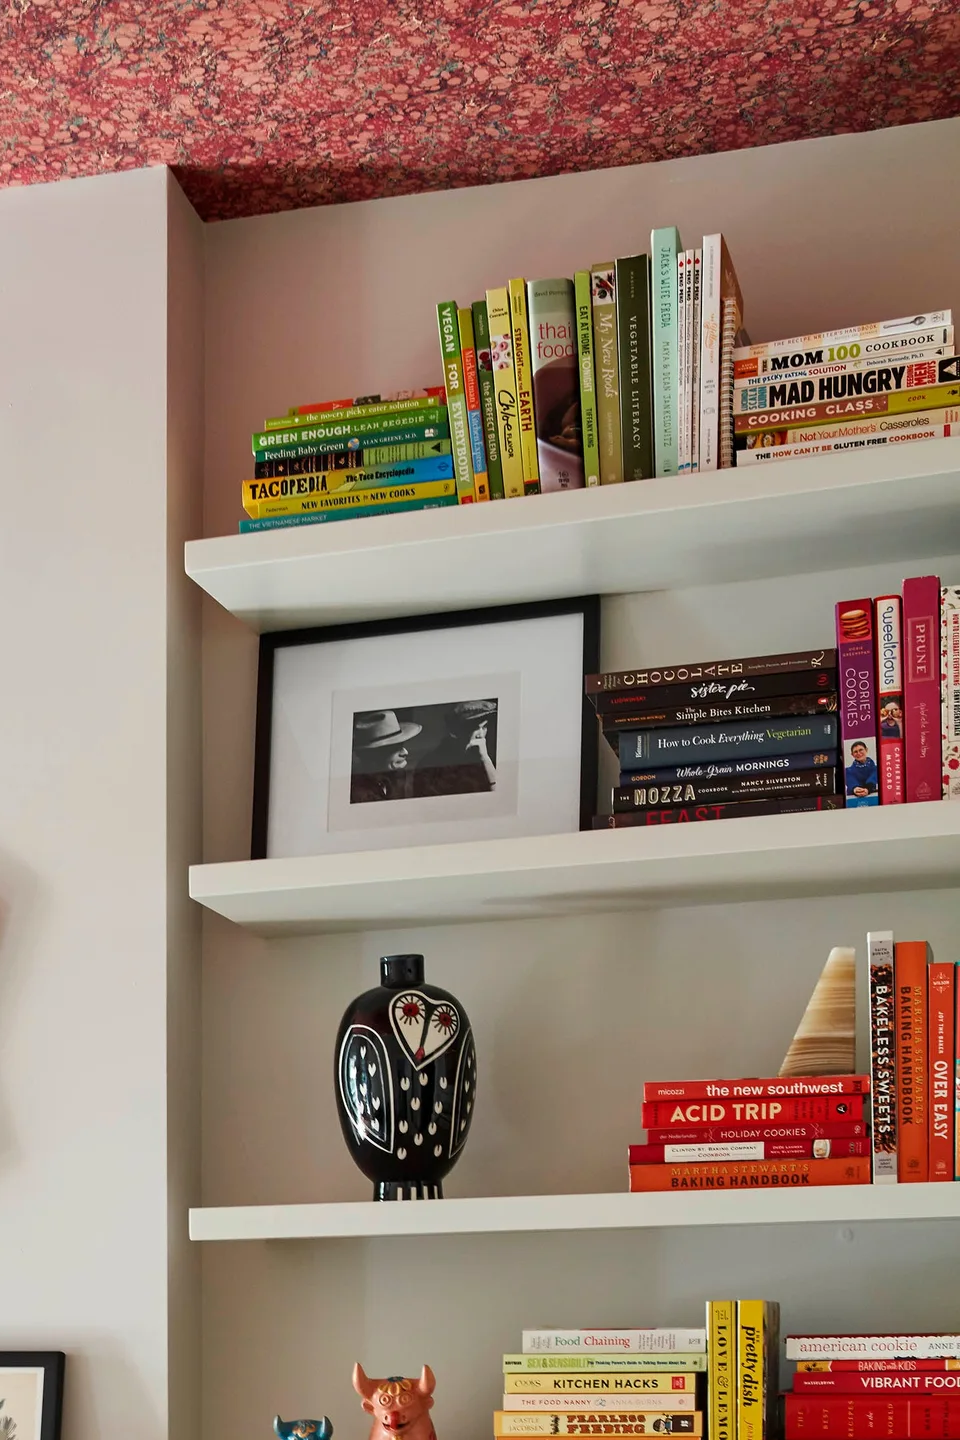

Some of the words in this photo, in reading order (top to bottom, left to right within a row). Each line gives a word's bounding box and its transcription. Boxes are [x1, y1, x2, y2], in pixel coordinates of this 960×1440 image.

[579, 306, 588, 320] EAT
[596, 313, 613, 333] My
[442, 307, 456, 353] VEGAN
[538, 322, 571, 340] thai
[581, 322, 589, 331] AT
[537, 341, 575, 359] food
[581, 333, 590, 356] HOME
[601, 337, 613, 365] New
[629, 315, 641, 384] VEGETABLE
[771, 350, 824, 371] MOM
[828, 343, 861, 362] 100
[865, 334, 935, 352] COOKBOOK
[448, 363, 459, 390] FOR
[514, 328, 524, 367] STRAIGHT
[520, 390, 532, 432] EARTH
[582, 356, 592, 393] TONIGHT
[601, 369, 618, 399] Roots
[914, 362, 927, 386] MEN
[769, 379, 815, 408] MAD
[819, 366, 906, 400] HUNGRY
[631, 390, 641, 449] LITERACY
[748, 408, 817, 425] COOKING
[825, 400, 874, 415] CLASS
[259, 432, 298, 447] GREEN
[301, 425, 351, 440] ENOUGH
[353, 422, 380, 431] LEAH
[452, 401, 470, 482] EVERYBODY
[800, 432, 816, 443] Not
[817, 430, 837, 439] Your
[838, 423, 877, 436] Mother's
[879, 417, 930, 431] Casseroles
[265, 449, 297, 461] Feeding
[297, 445, 318, 457] Baby
[319, 442, 345, 453] Green
[755, 452, 771, 460] THE
[772, 450, 792, 458] HOW
[833, 440, 865, 450] GLUTEN
[866, 437, 888, 446] FREE
[888, 430, 935, 443] COOKBOOK
[249, 475, 328, 500] TACOPEDIA
[345, 474, 358, 482] The
[359, 472, 374, 481] Taco
[375, 467, 415, 480] Encyclopedia
[301, 501, 319, 510] NEW
[320, 495, 361, 508] FAVORITES
[369, 491, 388, 501] NEW
[389, 488, 416, 499] COOKS
[249, 521, 261, 529] THE
[261, 518, 300, 528] VIETNAMESE
[301, 514, 328, 523] MARKET
[882, 606, 899, 685] weelicious
[915, 624, 927, 675] PRUNE
[623, 663, 743, 686] CHOCOLATE
[845, 668, 859, 727] COOKIES
[858, 670, 871, 721] DORIE'S
[676, 709, 707, 722] Simple
[709, 708, 732, 717] Bites
[735, 703, 771, 715] Kitchen
[658, 738, 679, 749] How
[681, 738, 691, 746] to
[692, 734, 717, 746] Cook
[718, 730, 765, 745] Everything
[766, 725, 812, 740] Vegetarian
[631, 774, 656, 782] GORDON
[676, 764, 733, 779] Whole-Grain
[736, 758, 790, 772] MORNINGS
[766, 776, 801, 785] SILVERTON
[875, 985, 890, 1065] BAKELESS
[900, 986, 912, 1041] BAKING
[658, 1088, 685, 1096] micozzi
[706, 1084, 730, 1097] the
[733, 1085, 764, 1096] new
[767, 1081, 844, 1095] southwest
[901, 1045, 913, 1125] HANDBOOK
[670, 1104, 726, 1123] ACID
[732, 1102, 782, 1121] TRIP
[877, 1071, 891, 1133] SWEETS
[720, 1130, 761, 1139] HOLIDAY
[763, 1128, 807, 1137] COOKIES
[671, 1167, 729, 1176] MARTHA
[733, 1163, 809, 1174] STEWART'S
[671, 1177, 725, 1188] BAKING
[730, 1173, 810, 1186] HANDBOOK
[555, 1336, 581, 1346] Food
[584, 1335, 631, 1348] Chaining
[717, 1325, 728, 1372] LOVE
[800, 1340, 867, 1353] american
[871, 1339, 918, 1352] cookie
[858, 1361, 887, 1372] BAKING
[898, 1361, 917, 1371] KIDS
[553, 1379, 610, 1389] KITCHEN
[614, 1379, 659, 1389] HACKS
[717, 1375, 729, 1388] &
[861, 1377, 921, 1388] VIBRANT
[566, 1414, 647, 1423] FEARLESS
[566, 1424, 646, 1434] FEEDING
